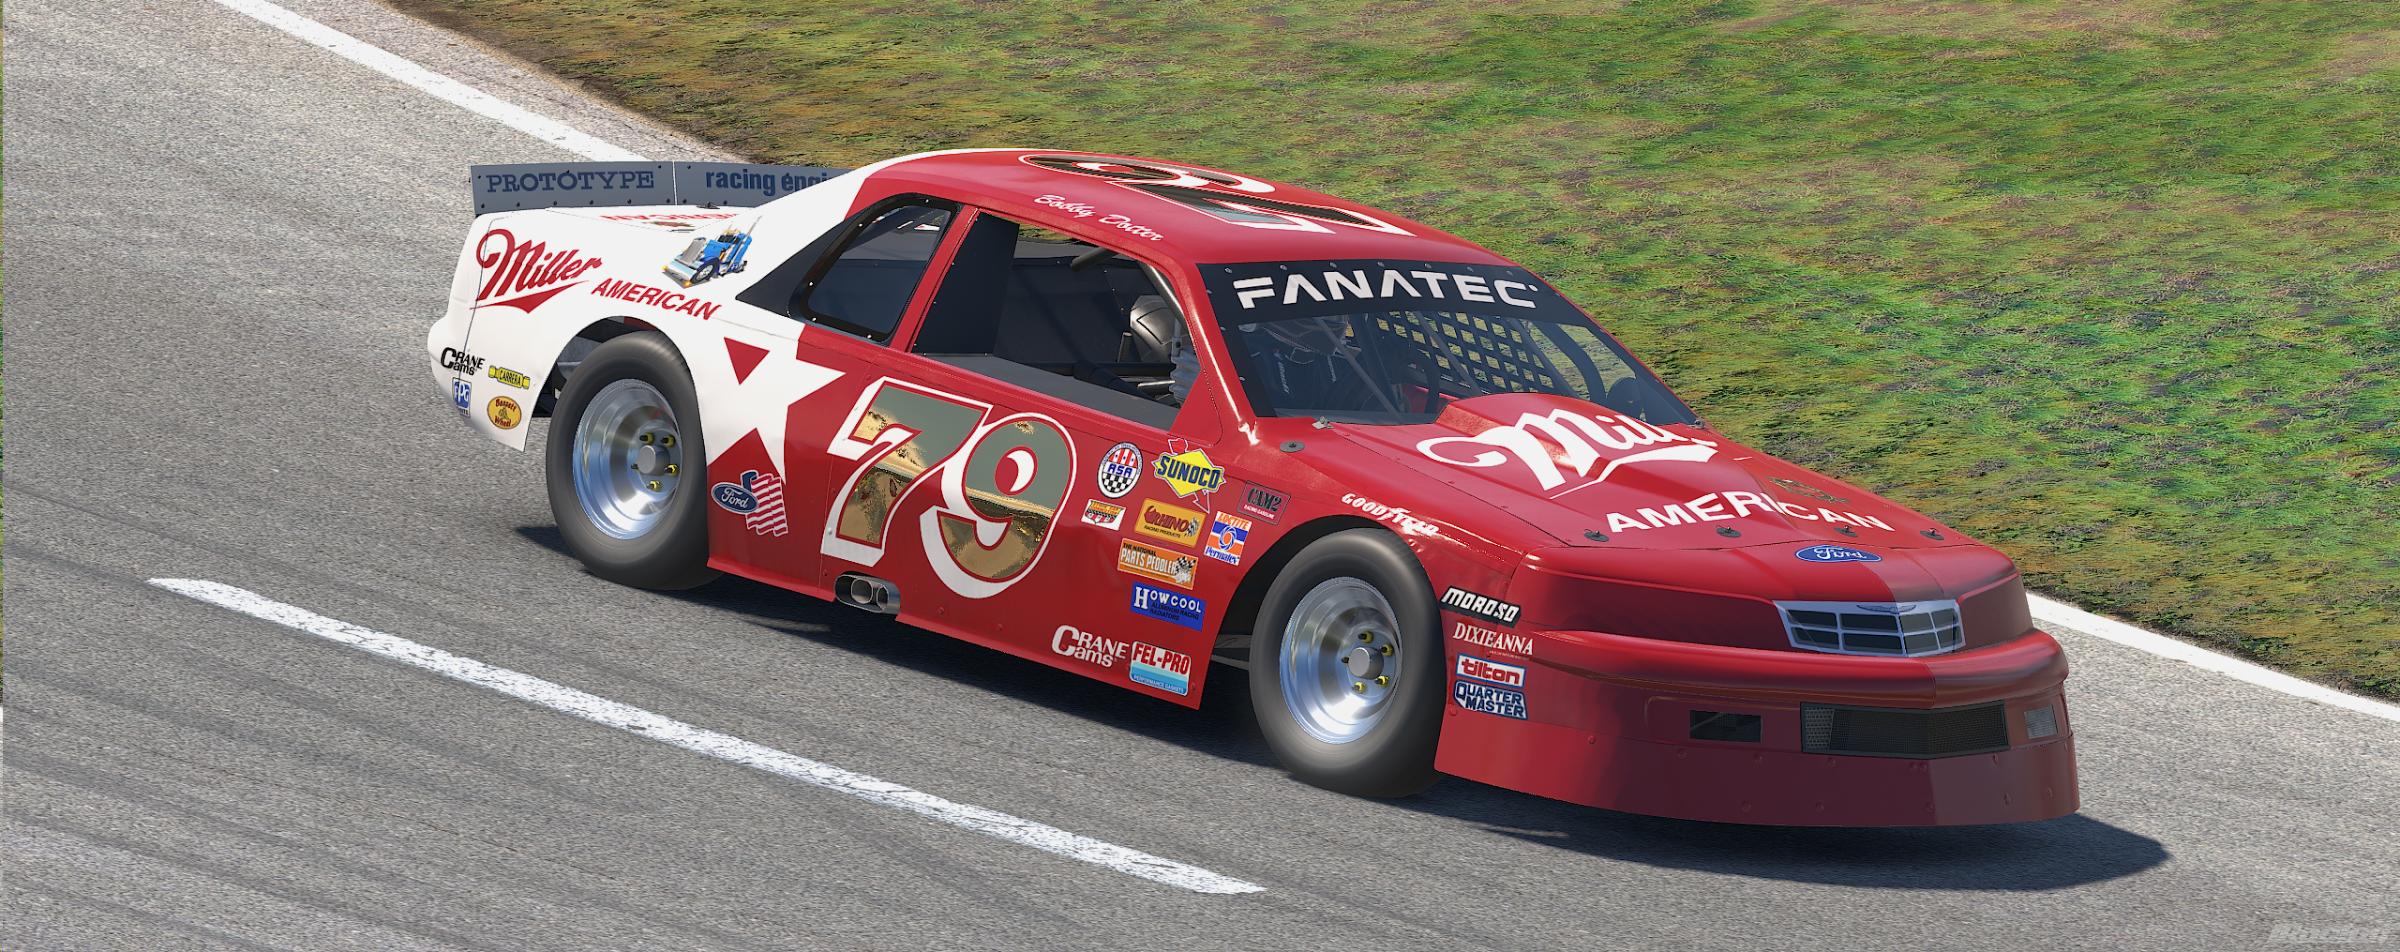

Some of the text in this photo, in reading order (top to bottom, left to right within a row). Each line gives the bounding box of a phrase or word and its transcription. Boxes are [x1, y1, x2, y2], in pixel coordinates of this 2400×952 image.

[486, 170, 655, 193] PROTOTYPE
[705, 170, 776, 197] racing
[1034, 194, 1096, 218] Bobby
[475, 228, 602, 301] Miller
[591, 277, 723, 321] AMERICAN
[1233, 269, 1538, 309] FANATEC
[454, 382, 470, 404] PPG
[1107, 463, 1133, 478] ASA
[1156, 455, 1222, 489] SUNOCO
[721, 487, 750, 508] Ford
[820, 376, 1077, 599] 79
[1605, 490, 1896, 534] AMERICAN
[1120, 547, 1145, 567] PARTS
[1146, 554, 1178, 576] PEDDLER
[1813, 547, 1867, 560] Ford
[1441, 587, 1520, 622] MOROSO
[1453, 622, 1534, 655] DIXIEANNA
[1132, 642, 1190, 675] FEL-PRO
[1461, 658, 1521, 685] tilton
[1455, 681, 1522, 705] QUARTER
[1466, 695, 1525, 718] MASTER
